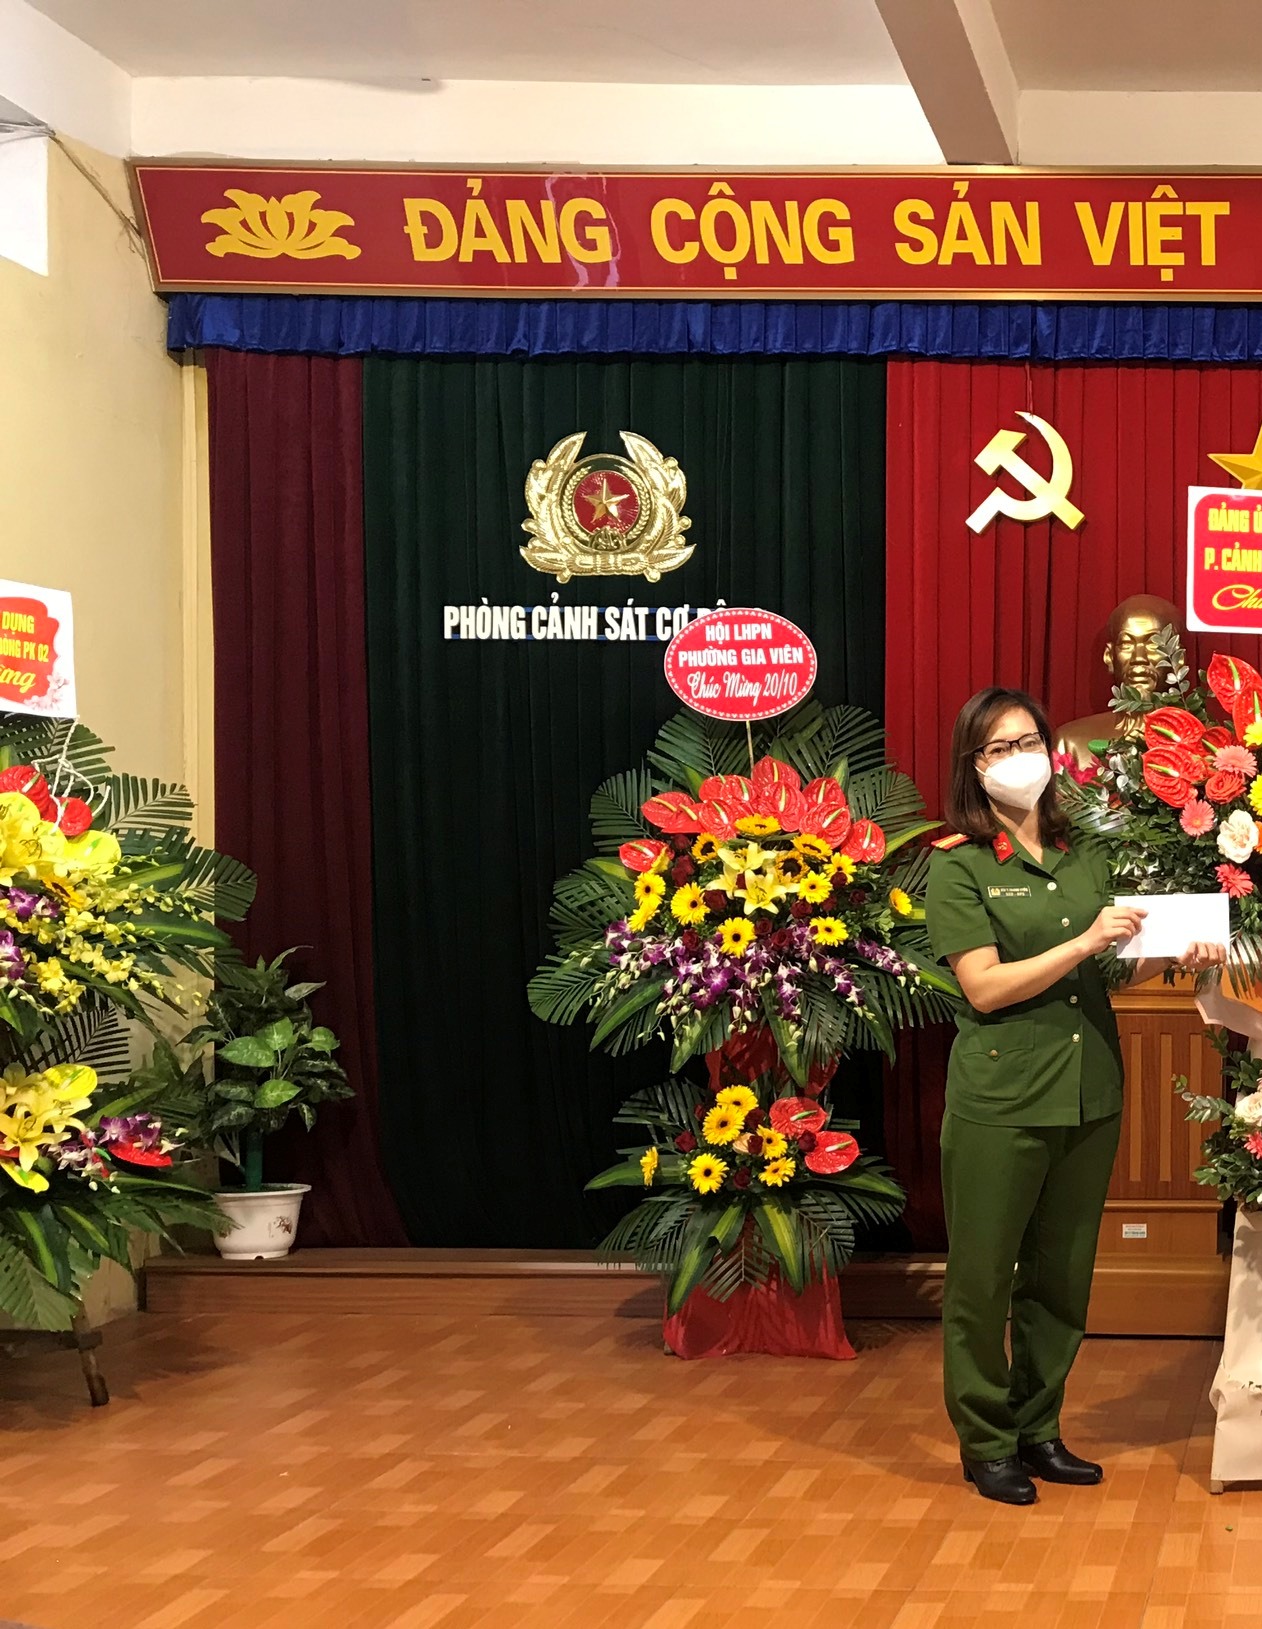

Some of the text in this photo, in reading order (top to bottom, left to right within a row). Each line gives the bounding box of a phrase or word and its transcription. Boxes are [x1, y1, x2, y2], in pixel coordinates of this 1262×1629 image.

[406, 179, 611, 264] ĐẢNG
[652, 183, 855, 280] CỘNG
[894, 182, 1041, 266] SẢN
[1076, 185, 1230, 281] VIỆT
[1208, 502, 1250, 533] ĐẢNG
[1204, 547, 1219, 571] P.
[1221, 542, 1262, 573] CẢNH
[444, 597, 526, 640] PHÒNG
[531, 592, 599, 640] CẢNH
[604, 599, 649, 641] SÁT
[705, 621, 773, 645] HỘI LHPN
[23, 641, 36, 661] PK
[678, 644, 804, 668] PHƯỜNG GIA VIÊN
[686, 669, 798, 707] Chúc Mừng 20/10
